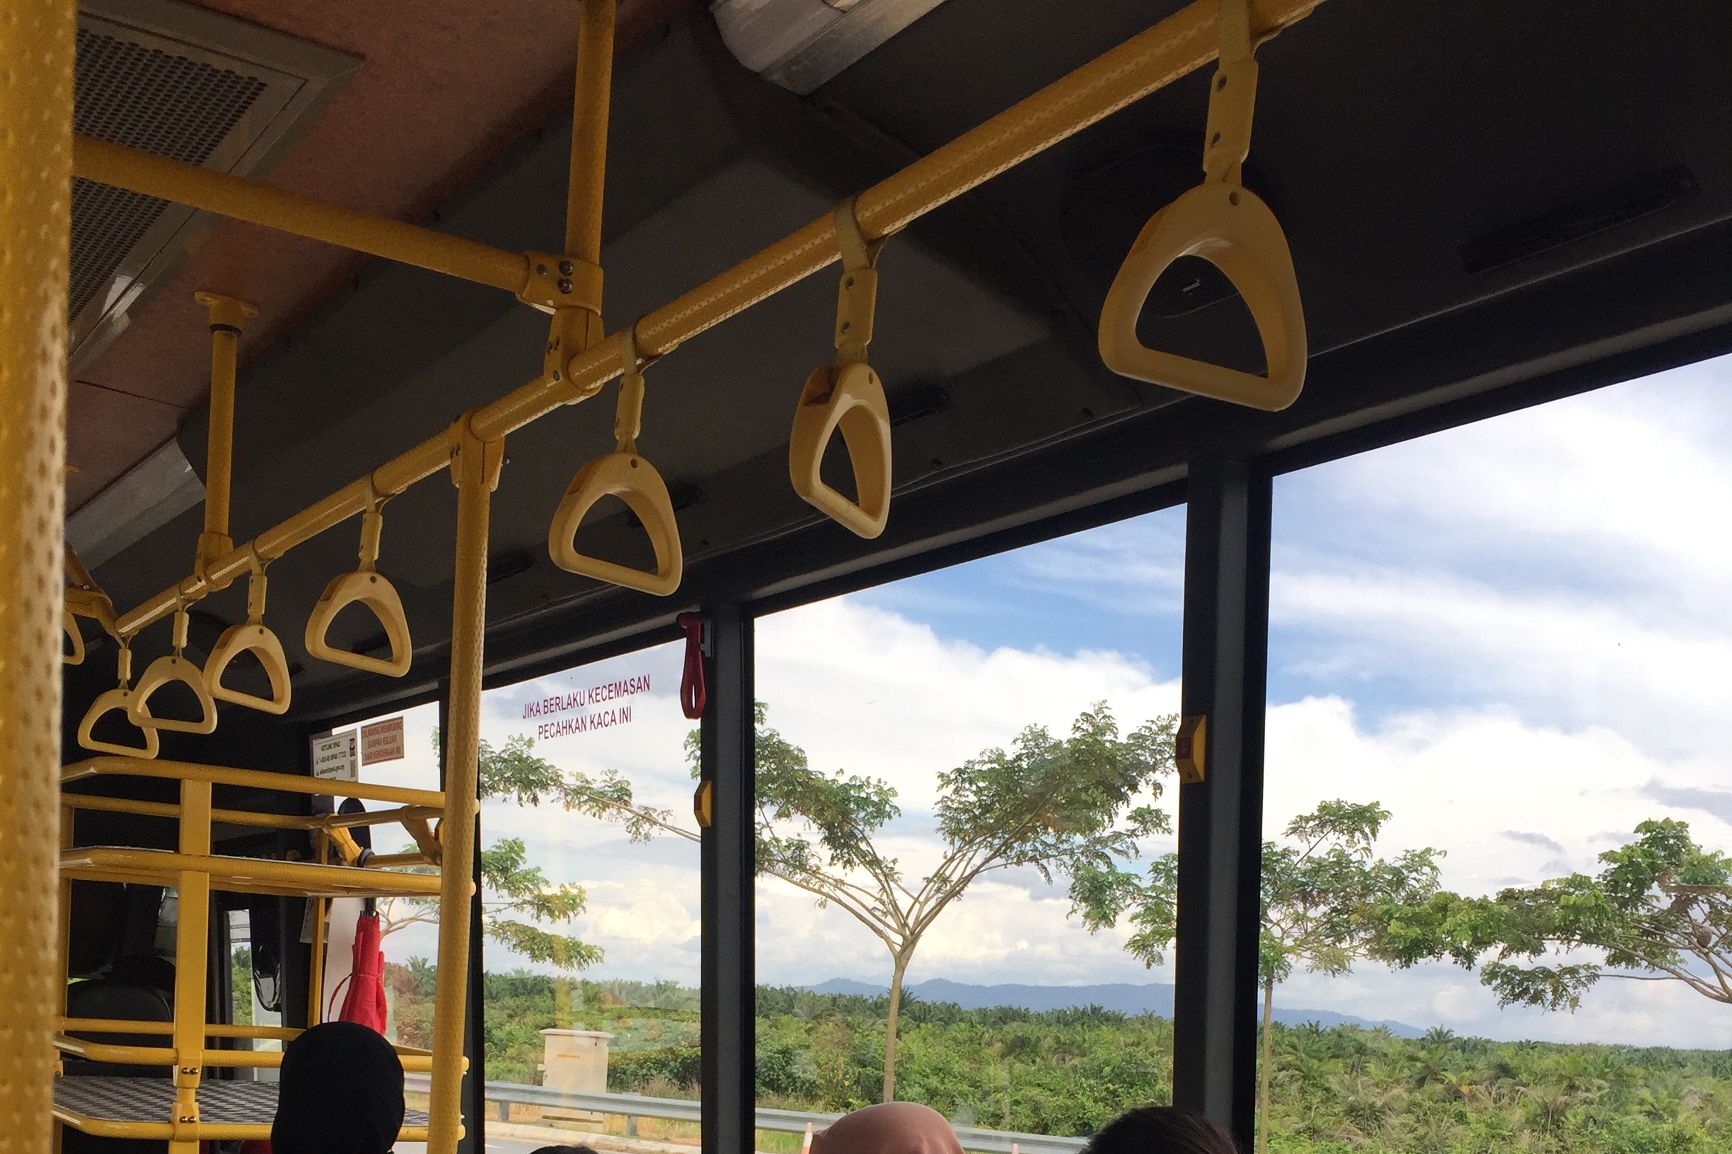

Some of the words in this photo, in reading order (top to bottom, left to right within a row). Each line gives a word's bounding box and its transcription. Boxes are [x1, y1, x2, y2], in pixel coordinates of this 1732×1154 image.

[522, 702, 541, 719] JIKA
[543, 690, 586, 715] BERLAKU
[588, 674, 651, 704] KECEMASAN
[538, 716, 587, 740] PECAHKAN
[590, 710, 617, 731] KACA
[619, 705, 632, 724] INI
